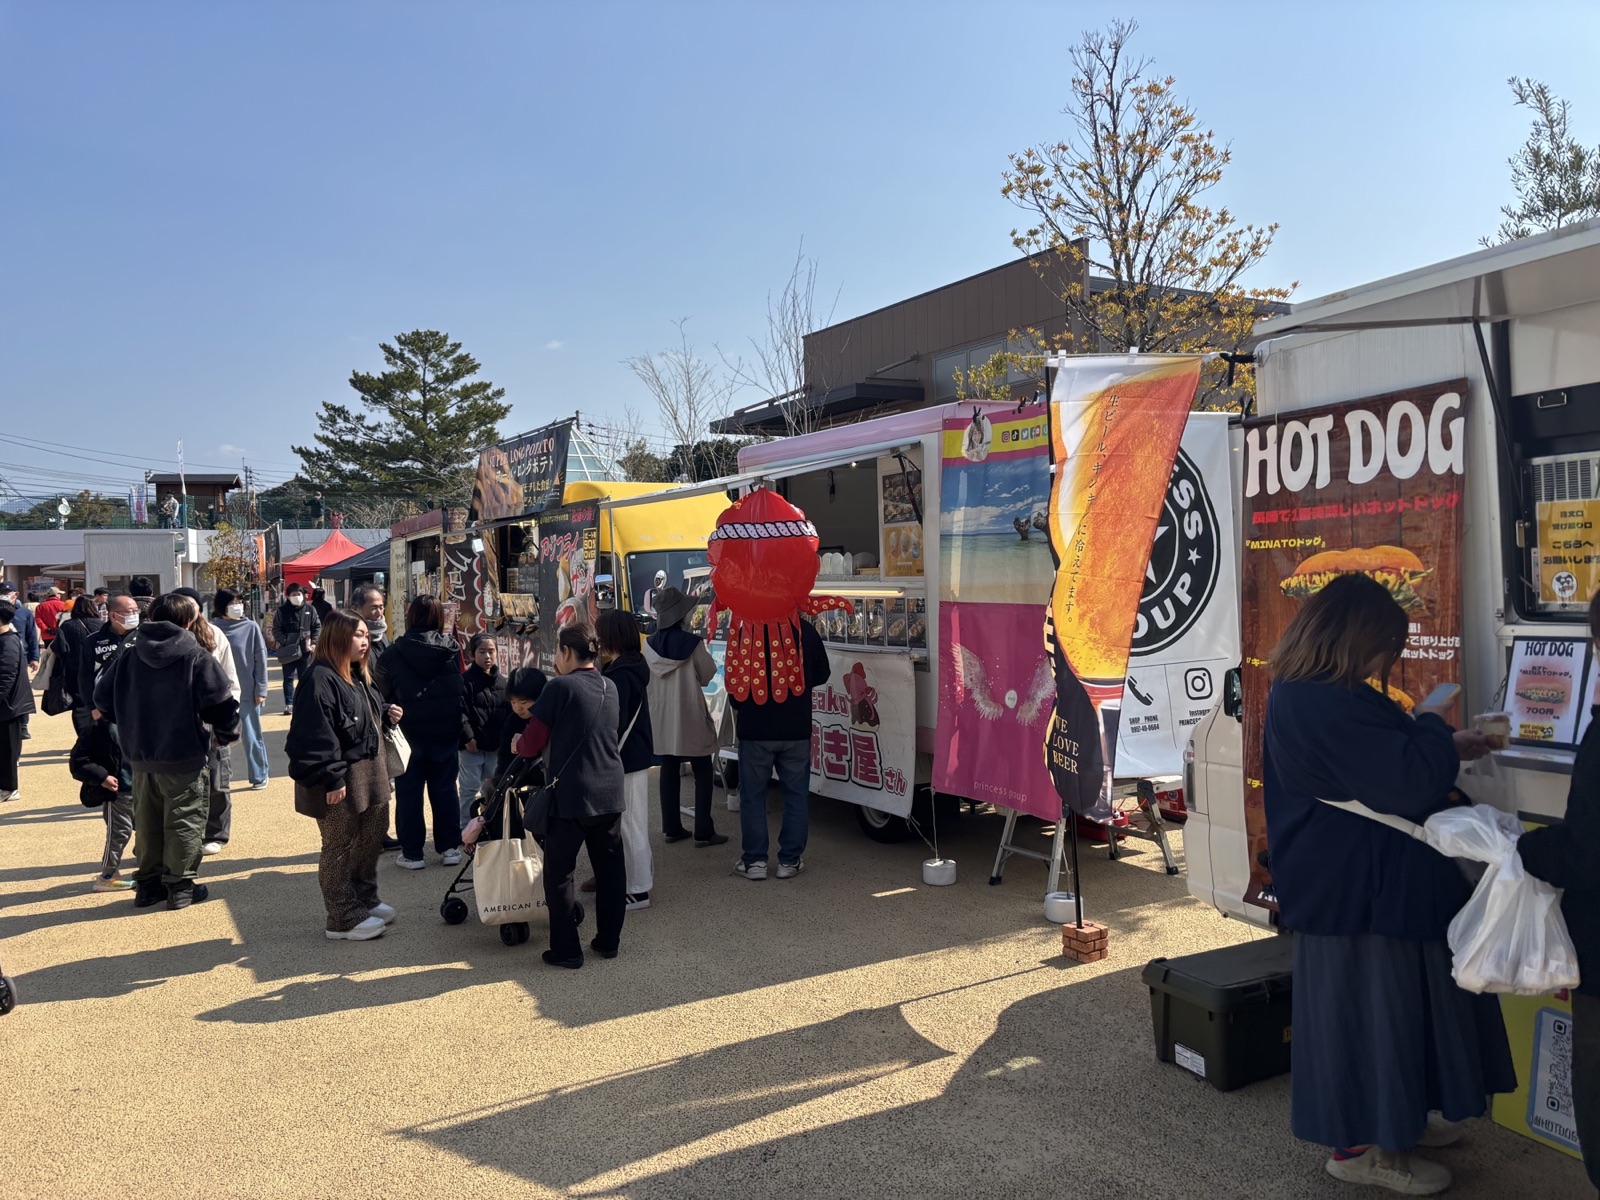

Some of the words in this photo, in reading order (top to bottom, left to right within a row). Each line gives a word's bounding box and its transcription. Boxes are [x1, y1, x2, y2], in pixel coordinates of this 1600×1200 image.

[525, 437, 555, 458] POTATO
[1245, 414, 1334, 497] HOT
[1345, 392, 1465, 484] DOG
[1552, 540, 1594, 549] こちらへ
[1406, 635, 1461, 647] で作り上げる
[1524, 641, 1548, 656] HOT
[1548, 642, 1574, 657] DOG
[1526, 706, 1554, 715] 700円
[1052, 733, 1080, 757] LOVE
[1052, 750, 1079, 775] BEER
[884, 767, 907, 796] さん
[973, 781, 1007, 796] princess
[483, 902, 531, 913] AMERICAN
